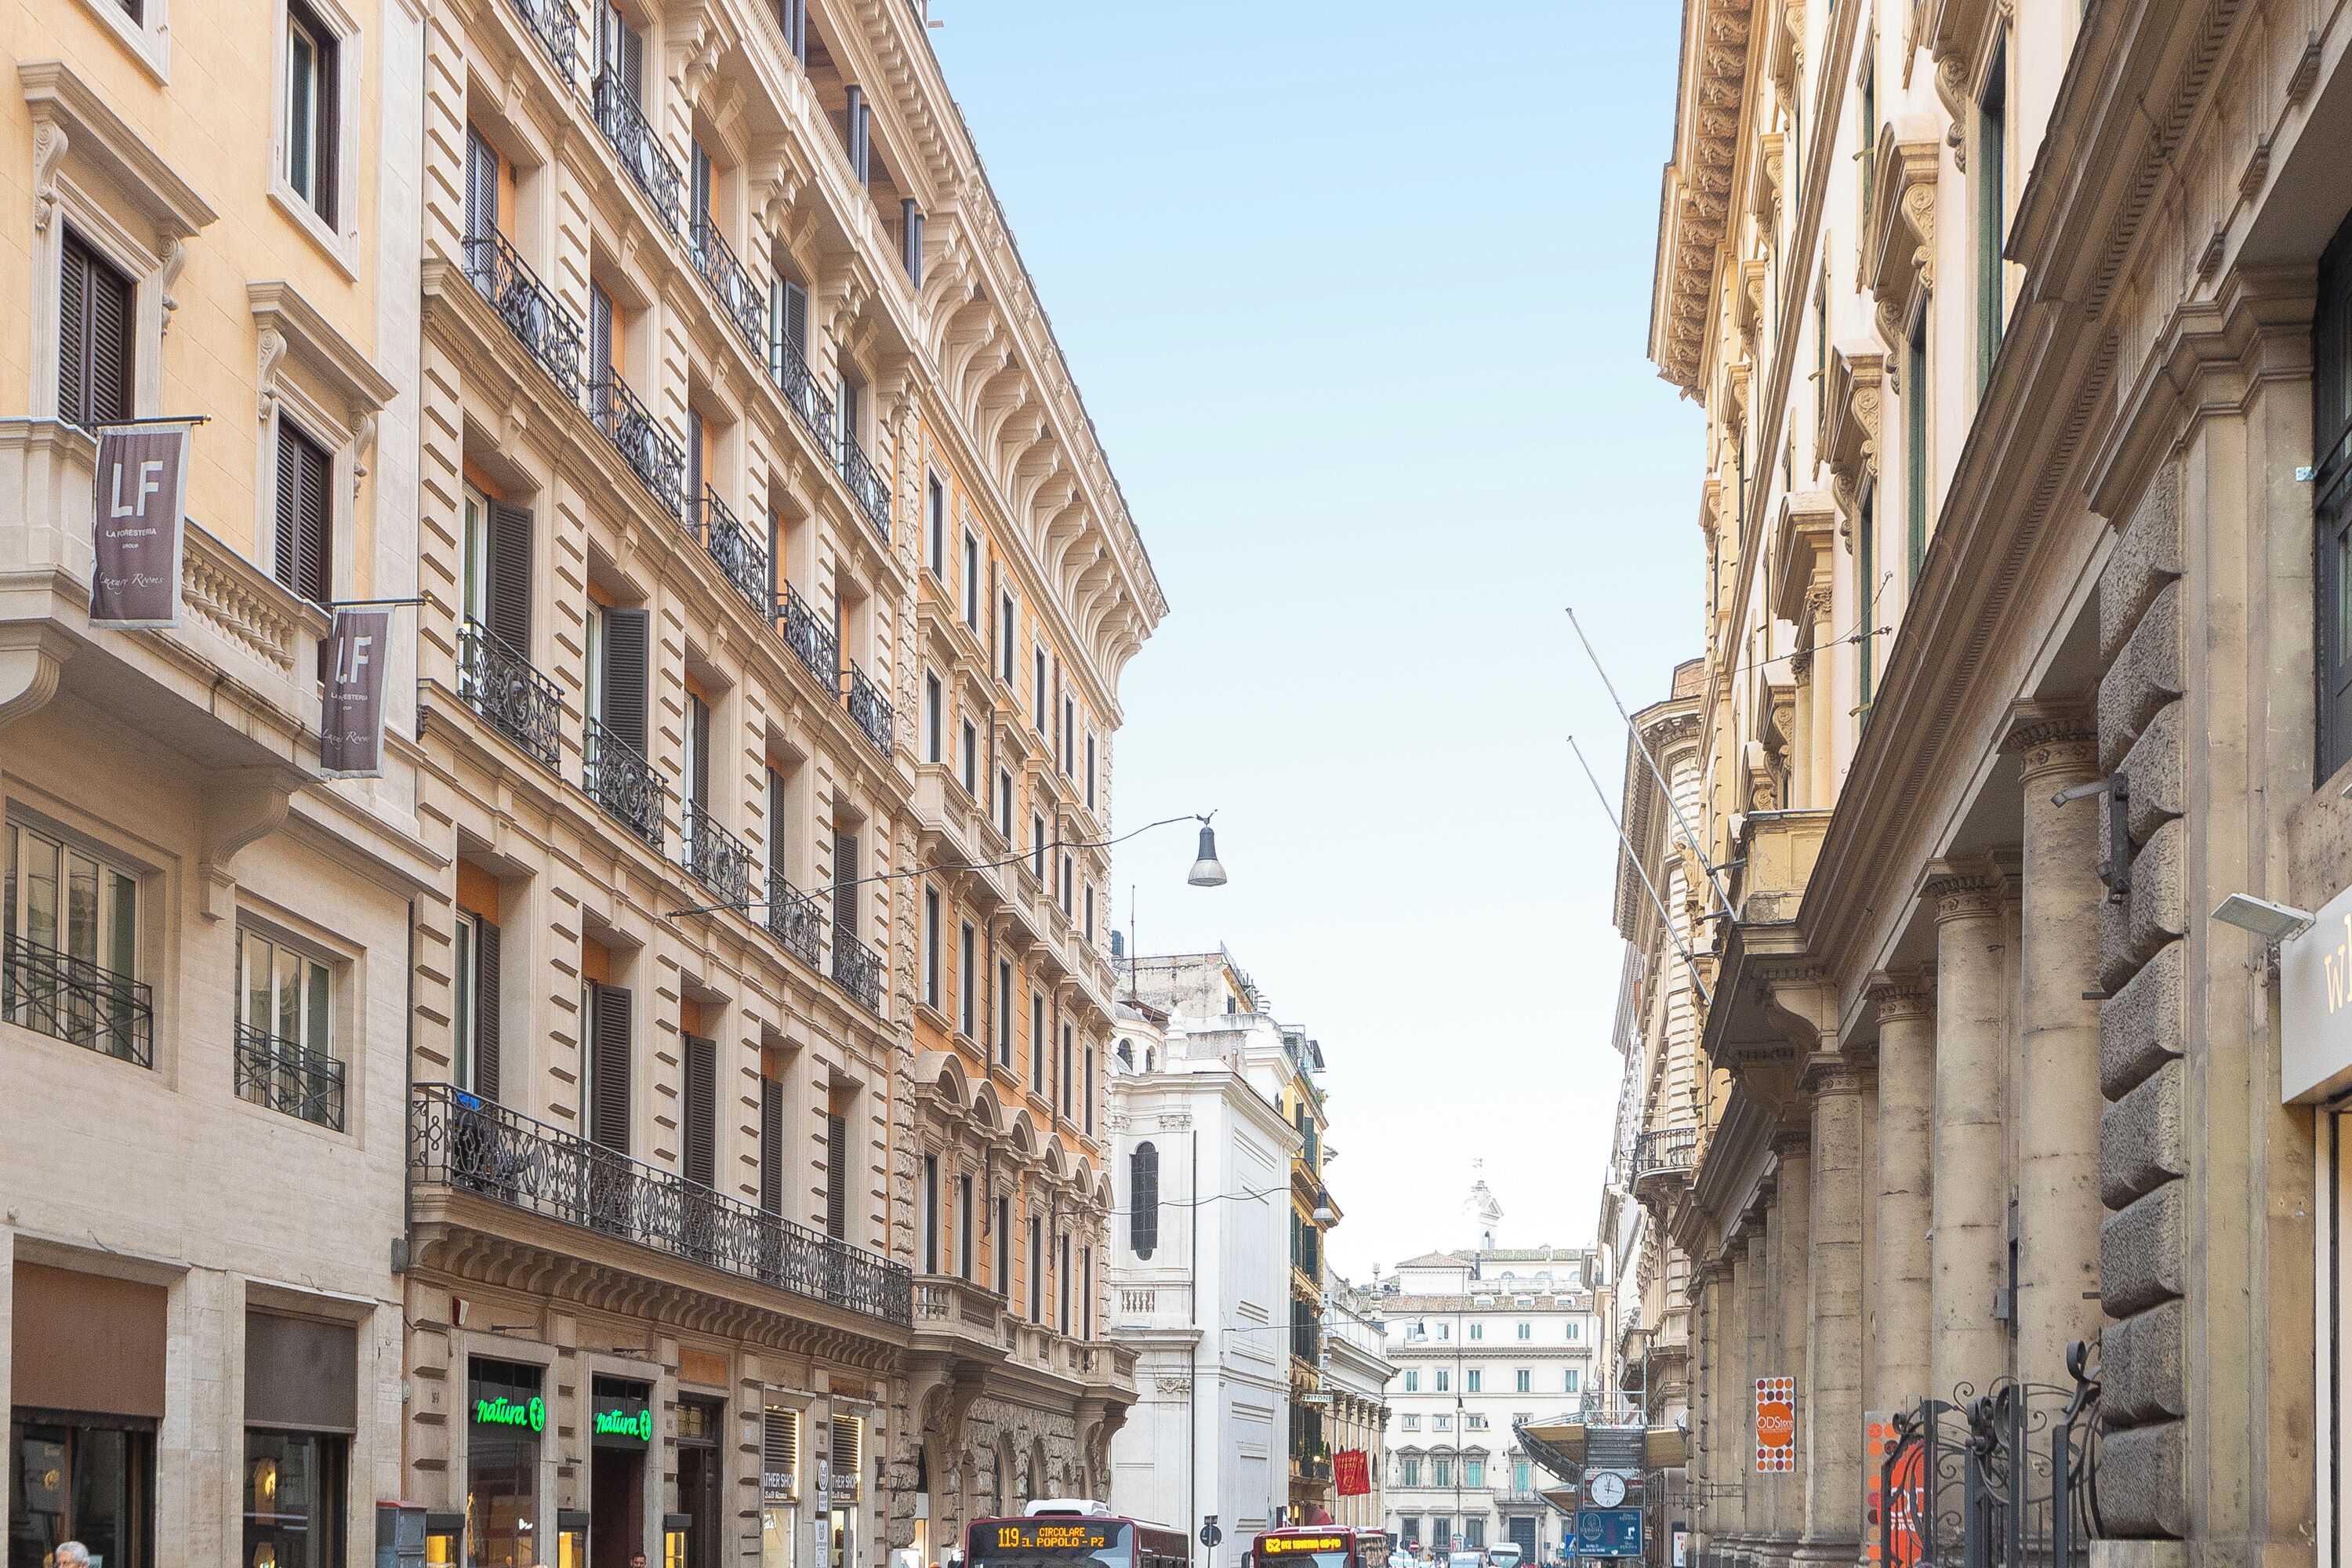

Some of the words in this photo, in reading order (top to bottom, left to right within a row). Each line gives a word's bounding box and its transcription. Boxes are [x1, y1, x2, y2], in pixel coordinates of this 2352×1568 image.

[111, 460, 164, 518] LF
[106, 529, 116, 538] LA
[117, 528, 157, 538] FORESTERIA
[132, 572, 163, 587] Rooms
[335, 636, 372, 684] LF
[1318, 1290, 1333, 1392] HOTEL
[477, 1396, 528, 1426] natura
[596, 1409, 640, 1436] natura
[764, 1472, 779, 1488] THER
[998, 1528, 1019, 1548] 119
[1039, 1527, 1085, 1537] CIRCOLARE
[1036, 1537, 1079, 1547] POPOLO
[1091, 1537, 1105, 1547] PZ
[1265, 1538, 1281, 1552] 62
